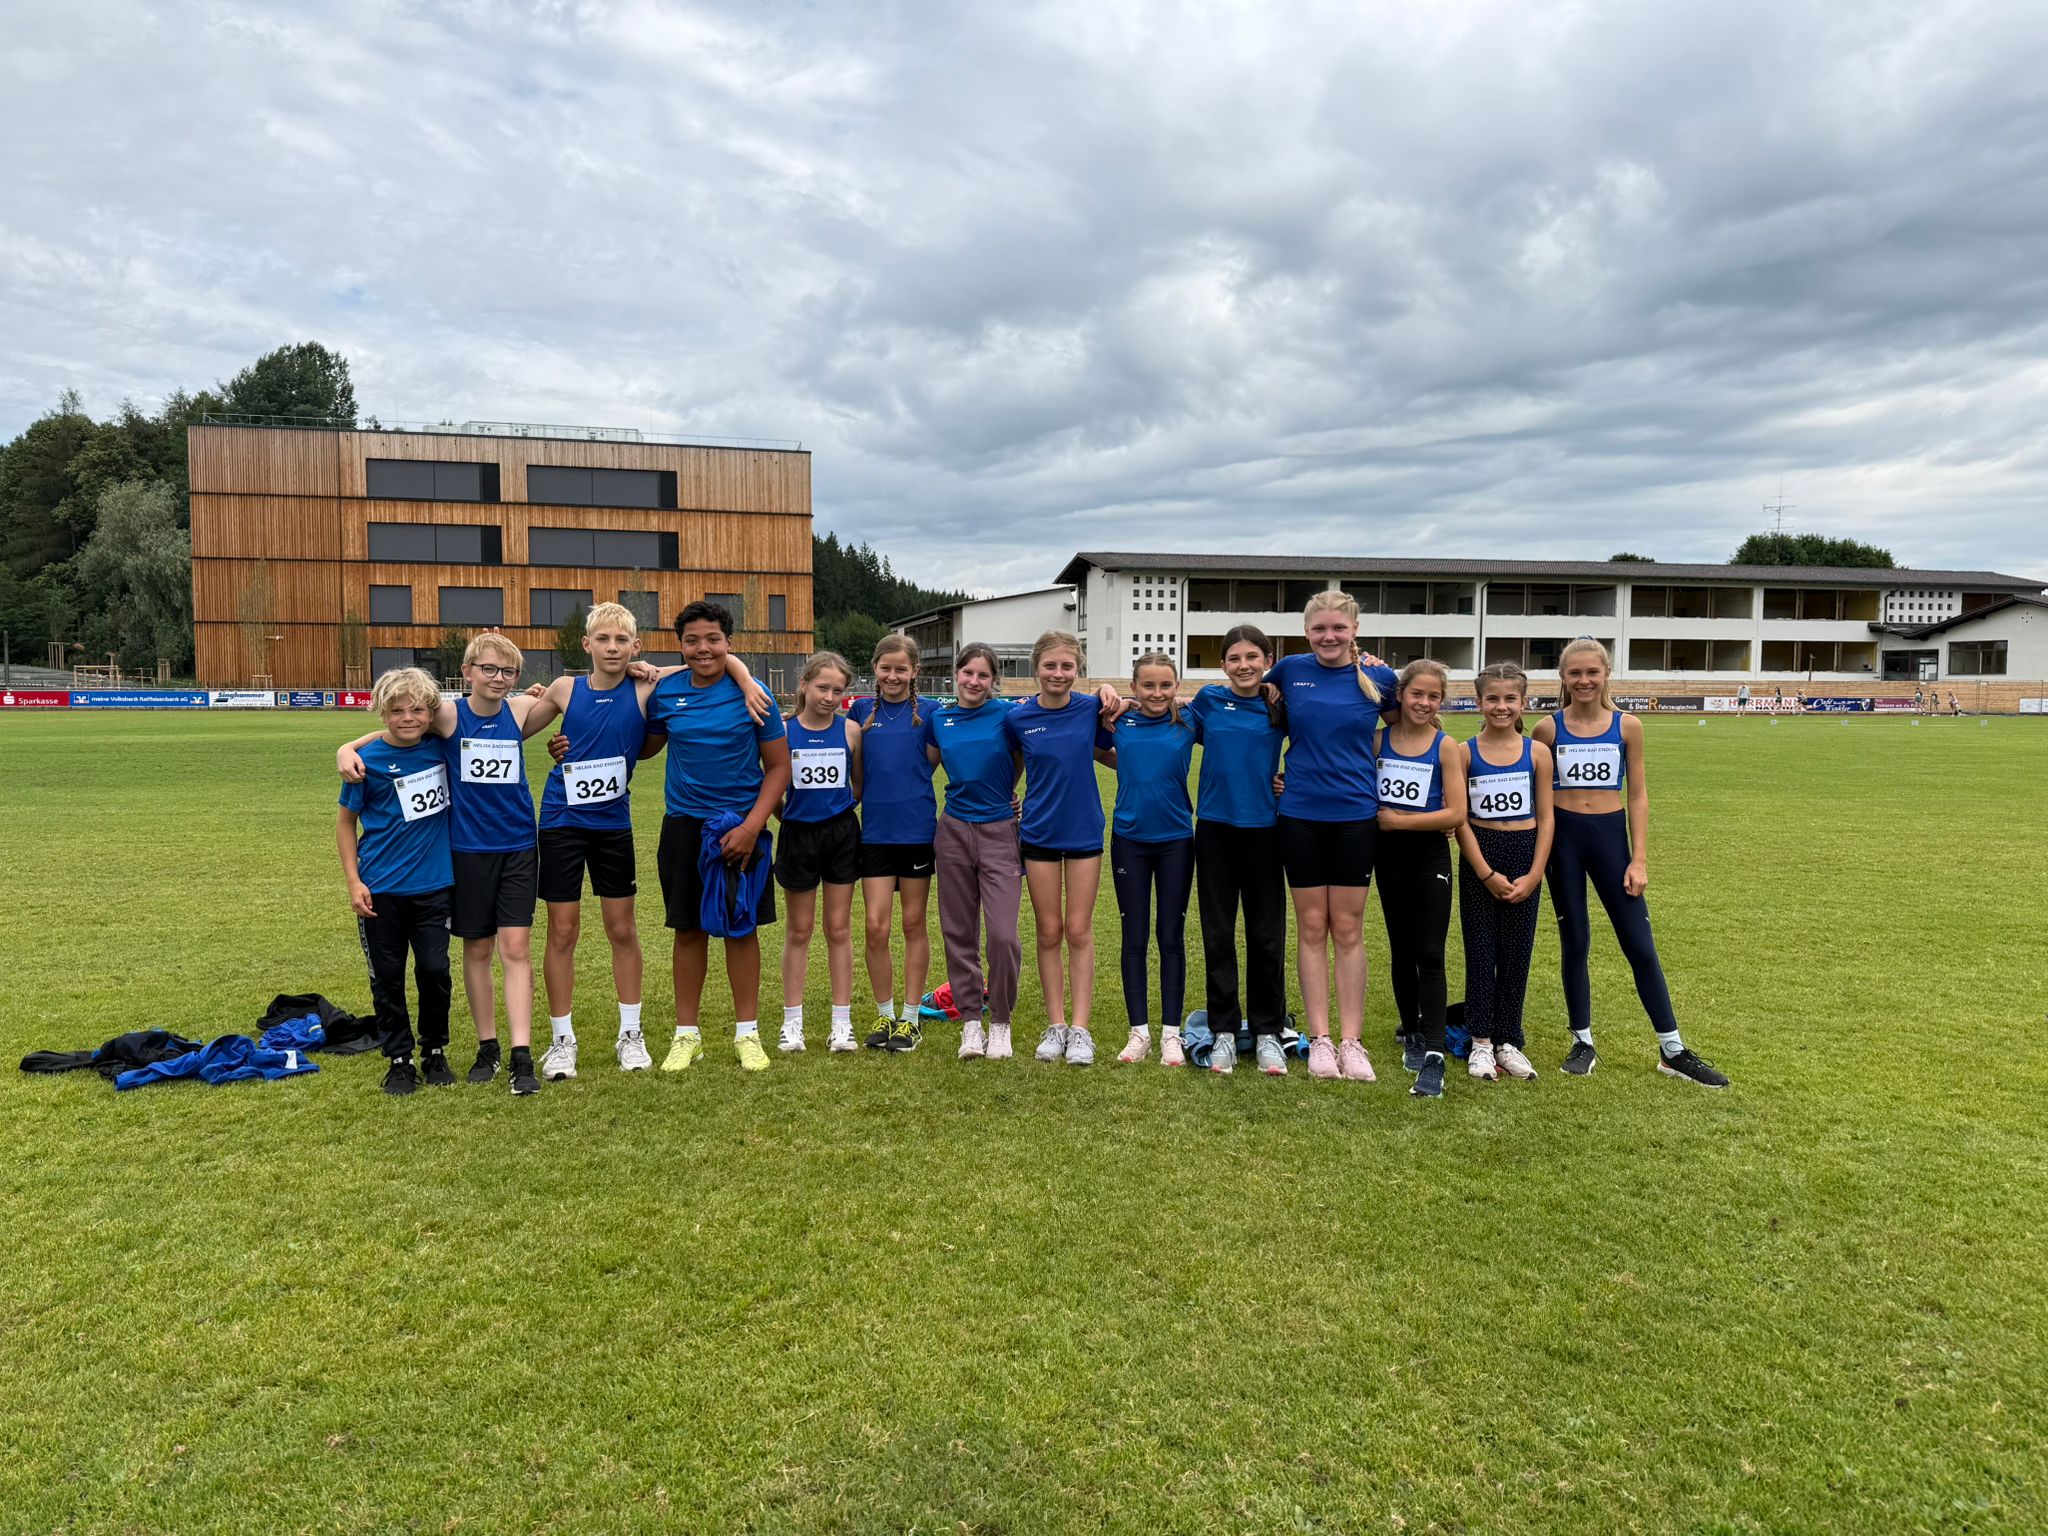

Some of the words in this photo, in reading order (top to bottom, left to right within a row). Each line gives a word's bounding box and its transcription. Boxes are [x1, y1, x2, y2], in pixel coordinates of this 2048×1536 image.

[18, 697, 59, 705] Sparkasse
[218, 691, 265, 699] Singhammer
[1813, 698, 1833, 707] Café
[470, 758, 512, 778] 327
[800, 765, 839, 784] 339
[1567, 762, 1611, 781] 488
[575, 776, 620, 799] 324
[1380, 777, 1420, 801] 336
[411, 785, 445, 813] 323
[1480, 791, 1523, 813] 489
